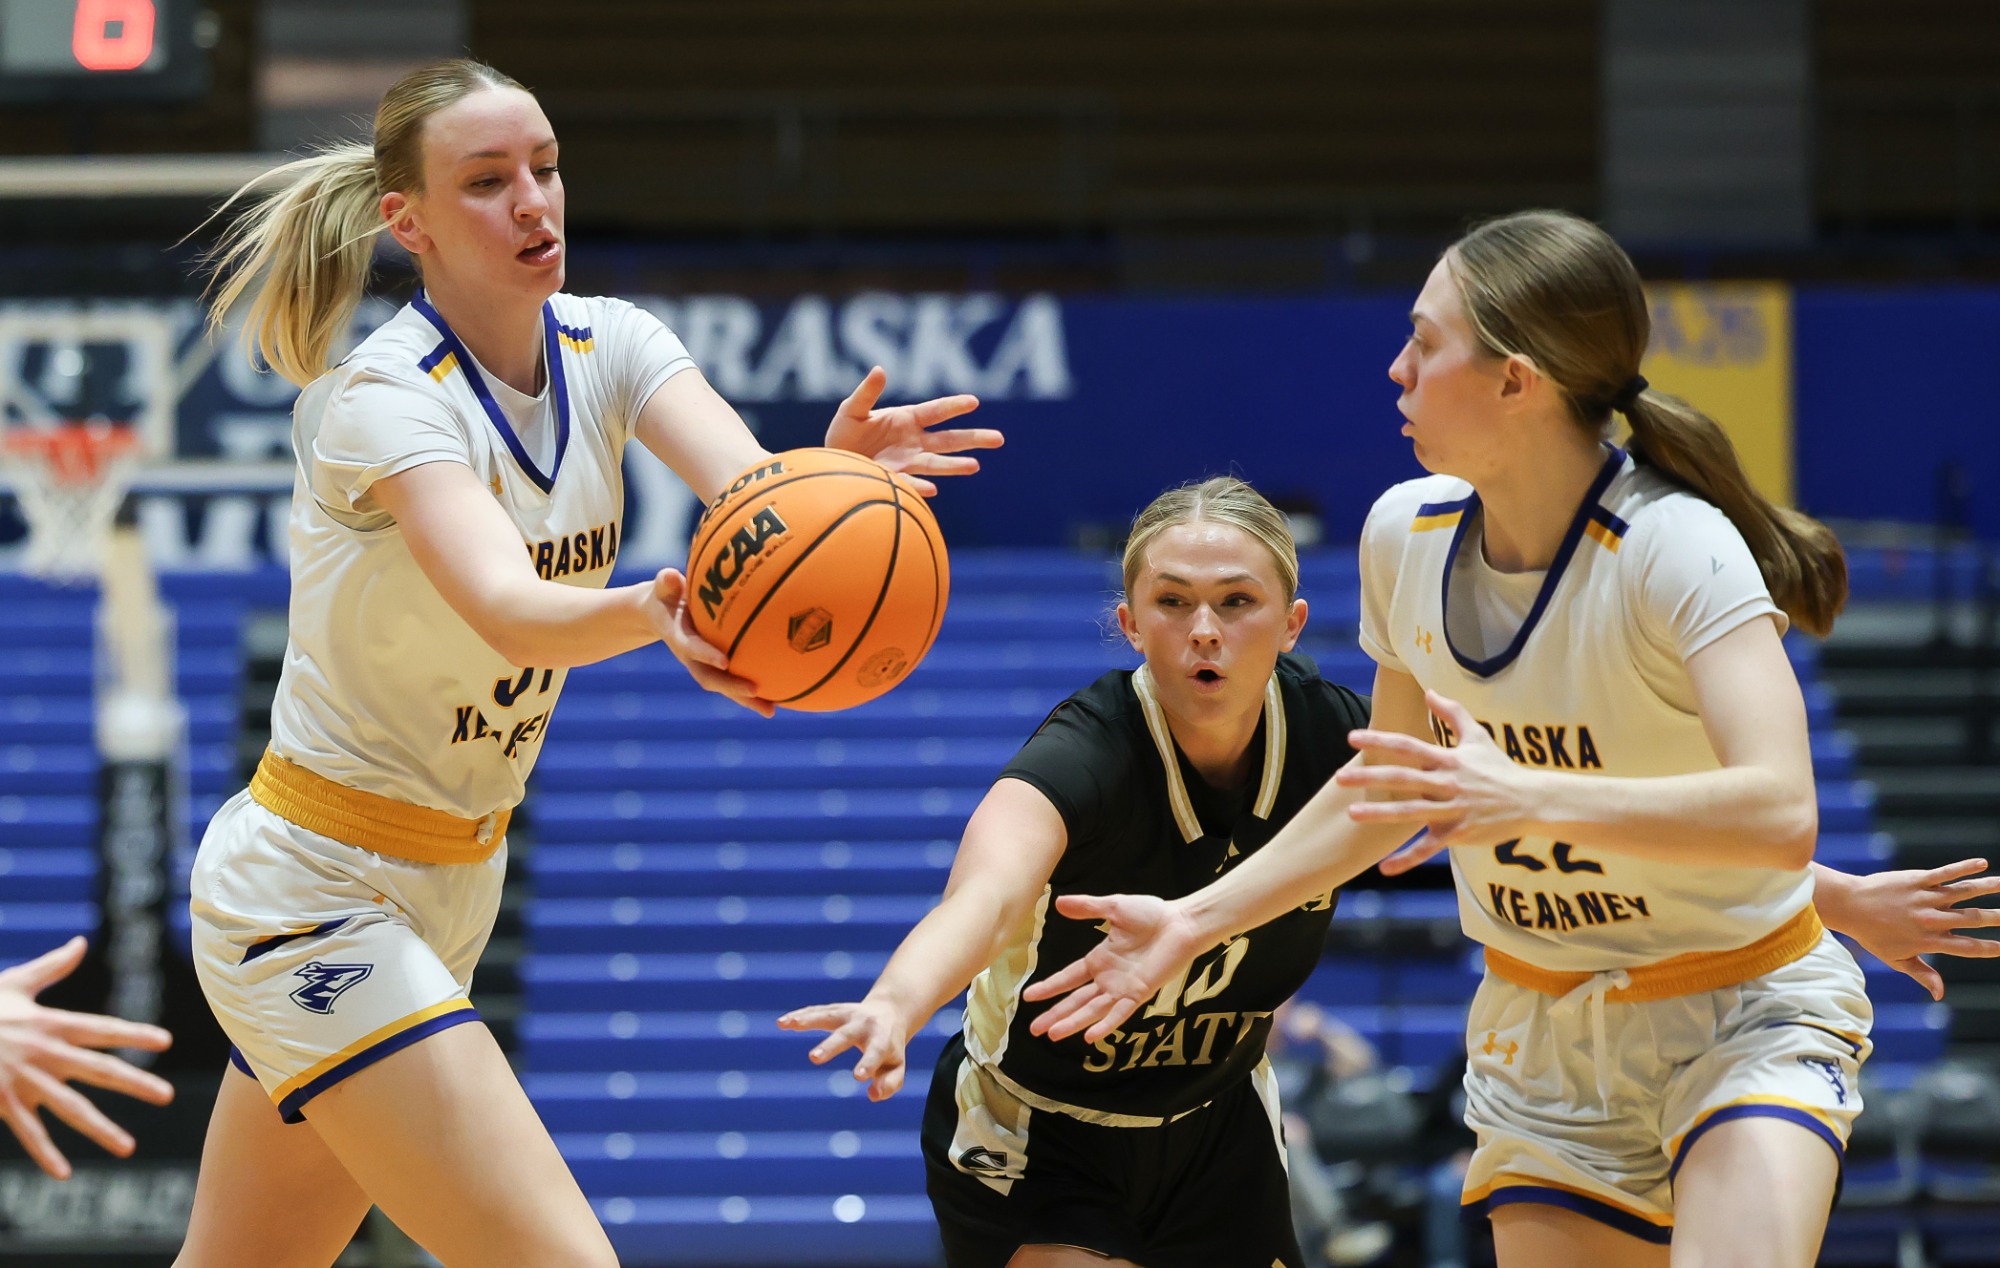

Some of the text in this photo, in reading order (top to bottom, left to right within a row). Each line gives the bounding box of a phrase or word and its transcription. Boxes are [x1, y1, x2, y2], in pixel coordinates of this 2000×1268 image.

[526, 521, 617, 580] RASKA
[698, 505, 788, 621] NCAA
[1488, 881, 1651, 933] KEARNEY
